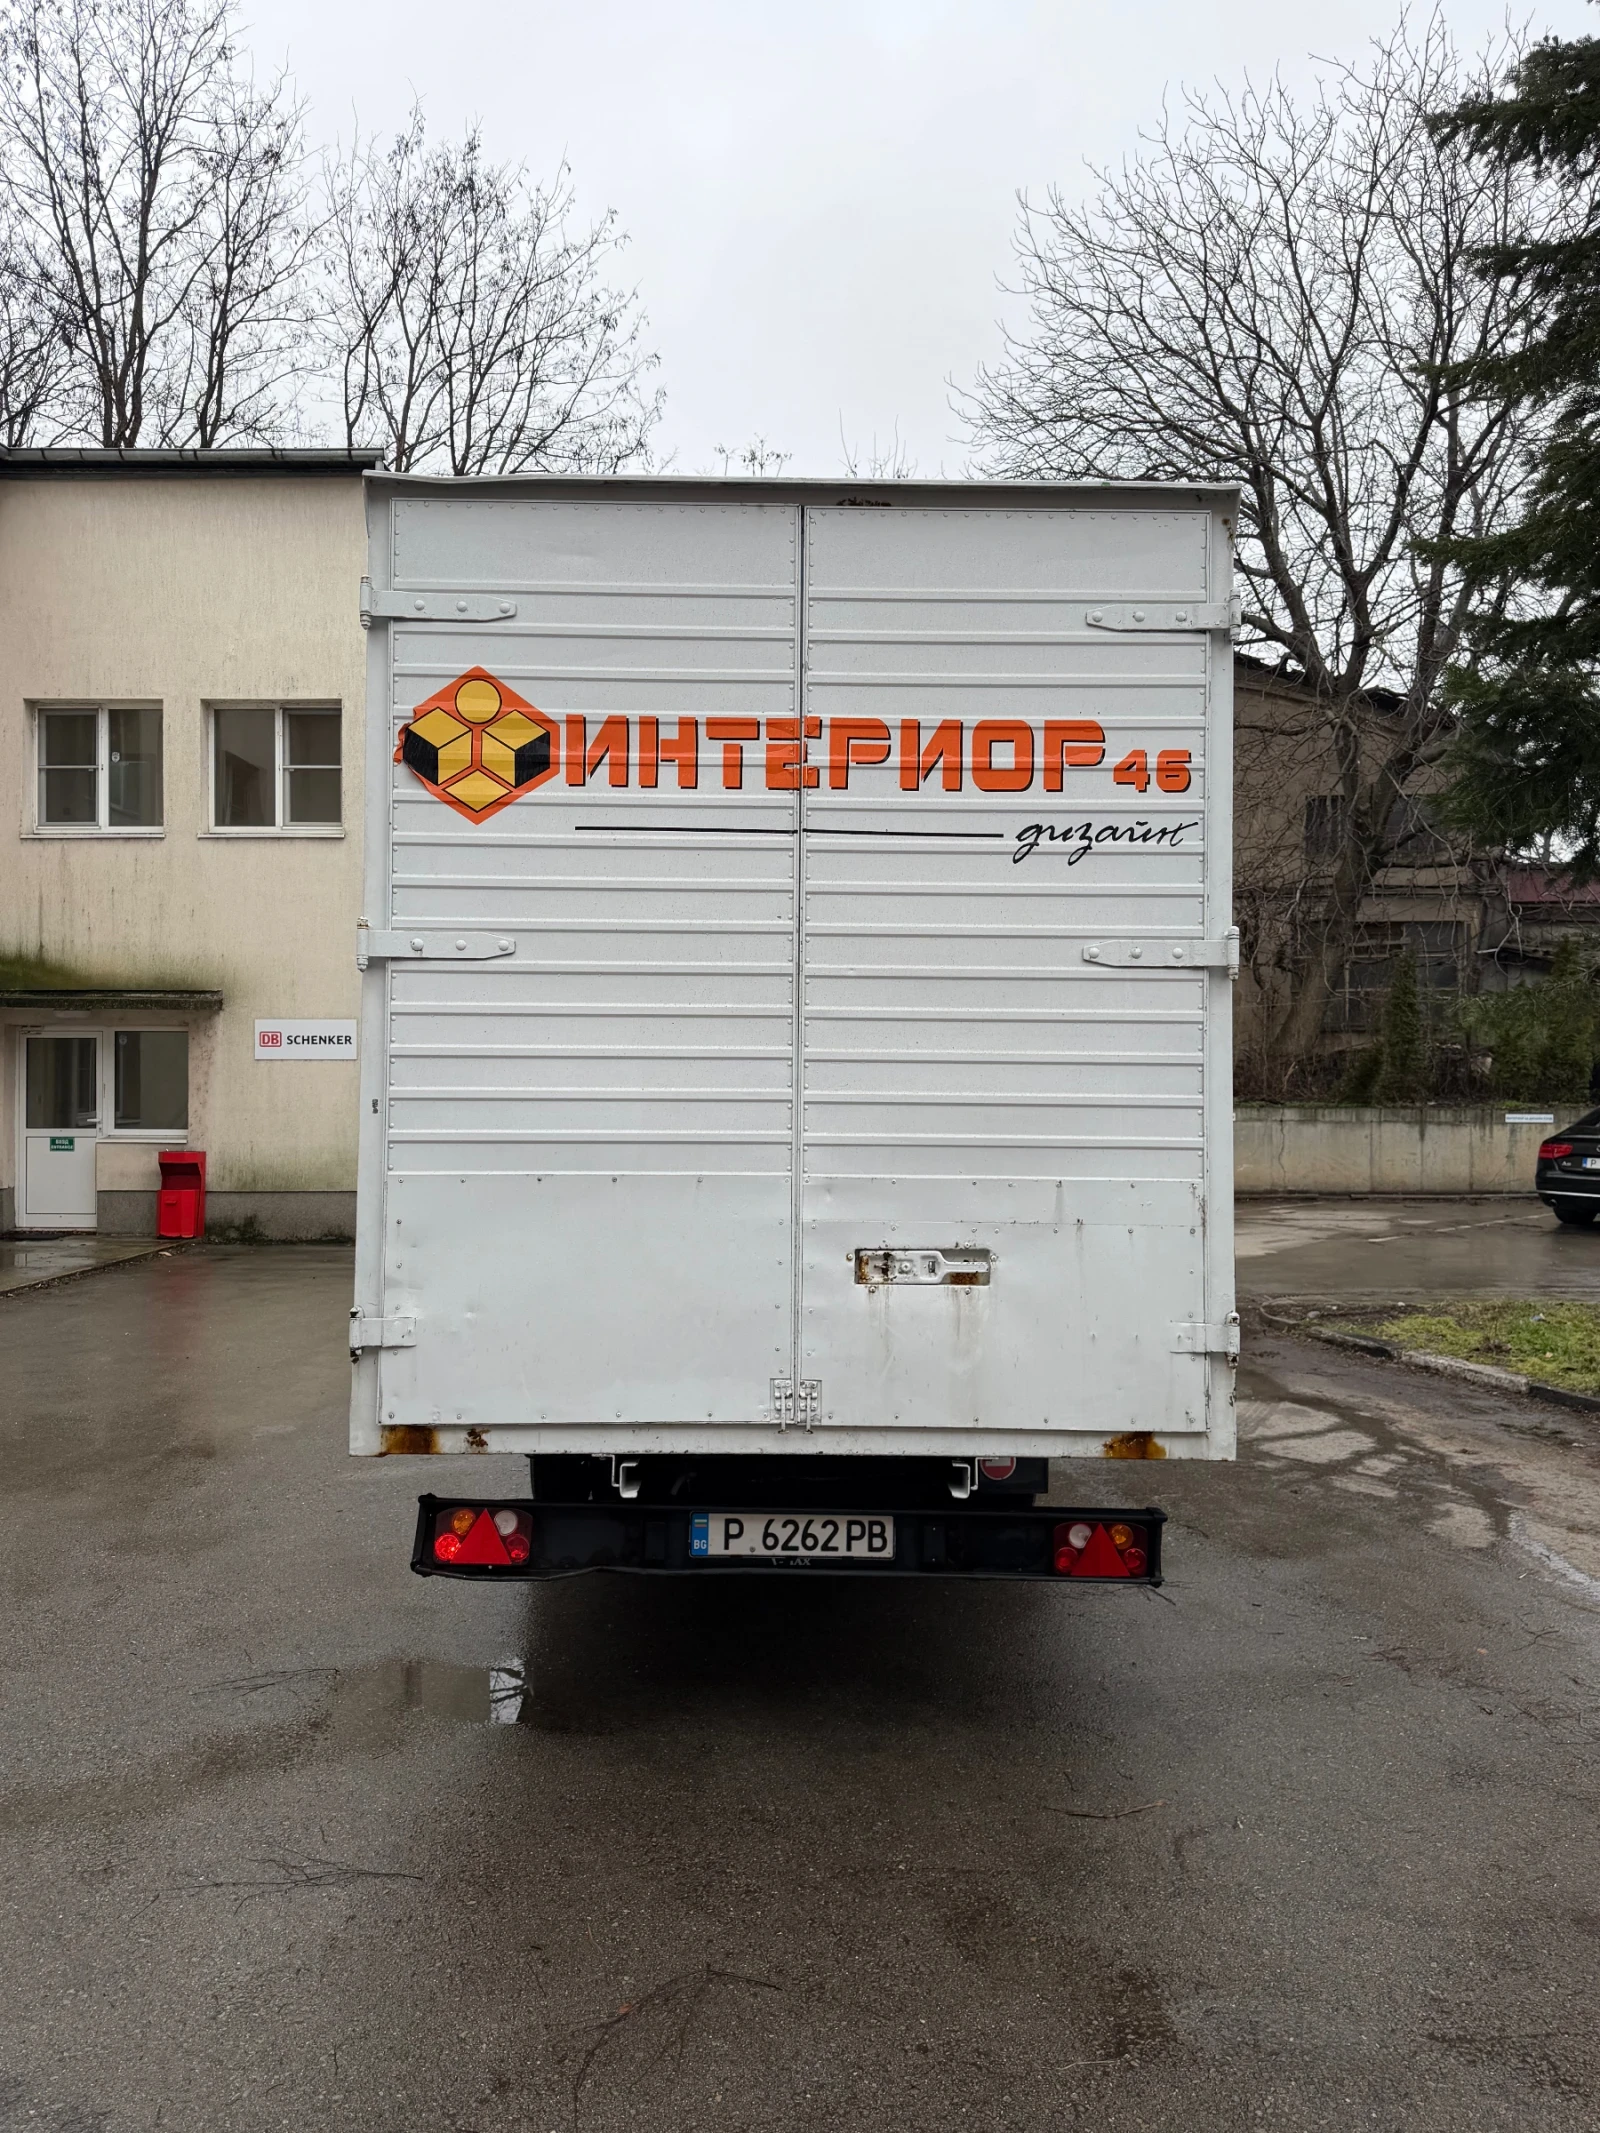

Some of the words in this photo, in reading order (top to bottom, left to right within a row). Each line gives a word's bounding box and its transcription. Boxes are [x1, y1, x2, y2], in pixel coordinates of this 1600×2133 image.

[566, 714, 1106, 793] ИНТЕРИОР
[1113, 749, 1192, 793] 46
[1012, 821, 1199, 867] дизайн
[261, 1033, 280, 1045] DB
[286, 1035, 352, 1045] SCHENKER
[693, 1539, 708, 1550] BG
[723, 1518, 745, 1551] P
